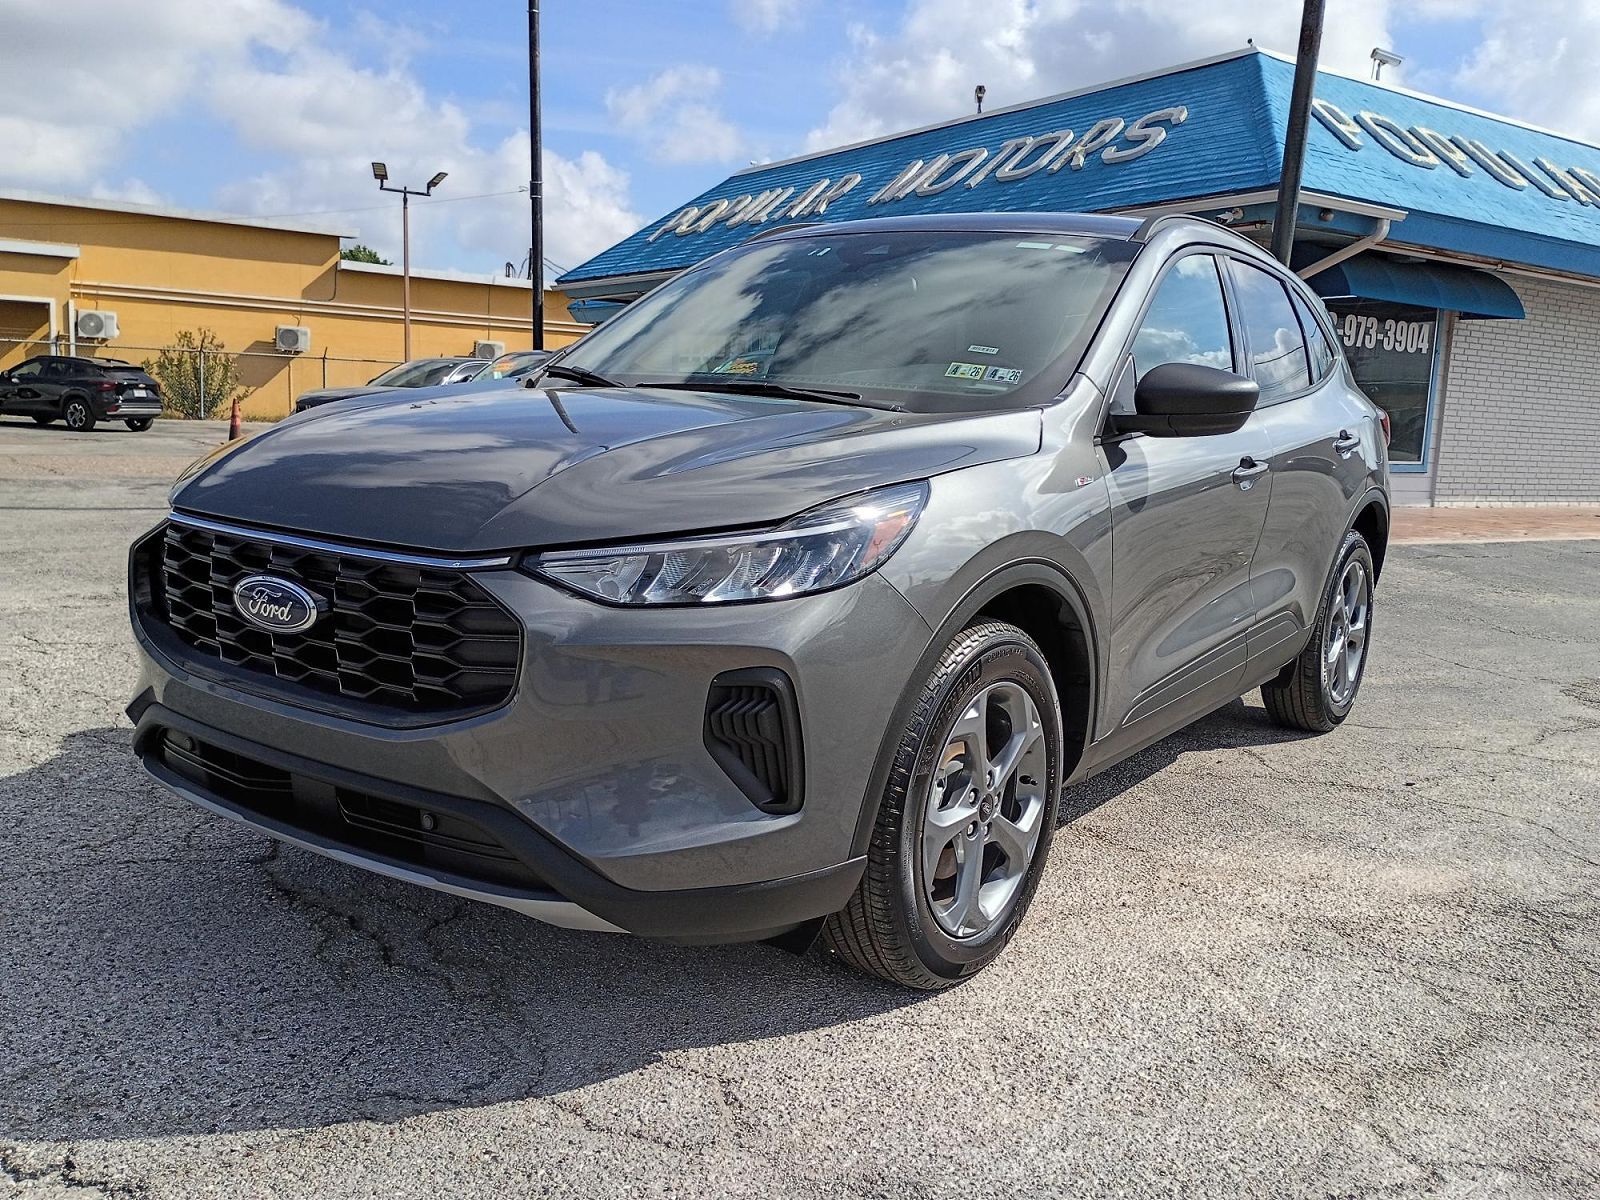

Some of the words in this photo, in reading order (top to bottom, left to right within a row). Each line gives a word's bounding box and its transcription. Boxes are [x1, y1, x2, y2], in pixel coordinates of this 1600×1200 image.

[647, 173, 862, 243] POPULAR
[866, 105, 1188, 206] MOTORS
[248, 587, 293, 622] Ford
